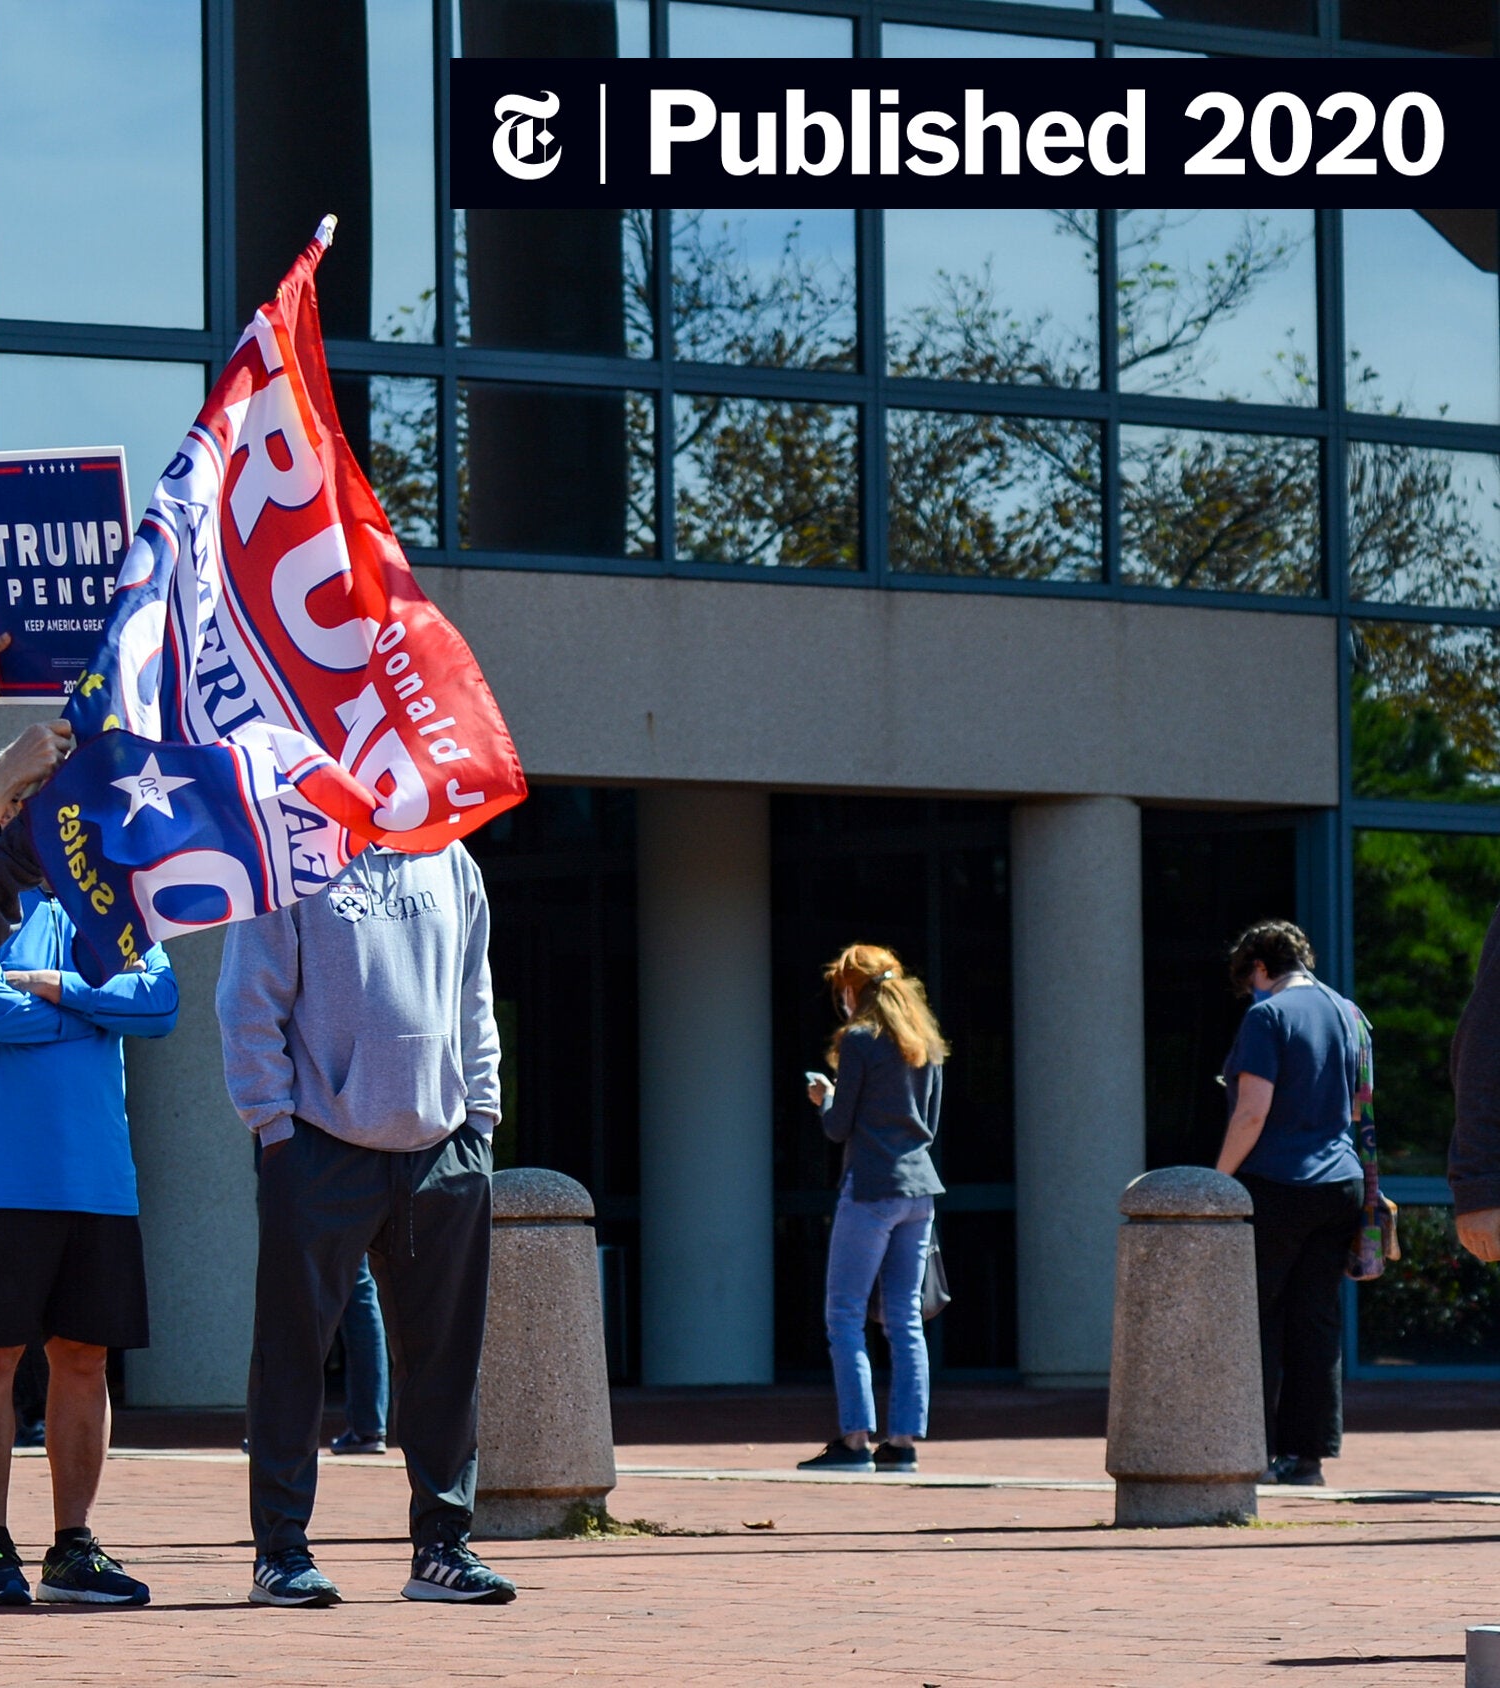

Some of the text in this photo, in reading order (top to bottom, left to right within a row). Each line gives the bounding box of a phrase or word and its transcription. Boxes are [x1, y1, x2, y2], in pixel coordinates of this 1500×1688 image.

[7, 576, 116, 606] PENCE
[24, 618, 106, 632] KEEP AMERICA GREA
[376, 621, 486, 824] Donald J.
[369, 889, 437, 917] Penn
